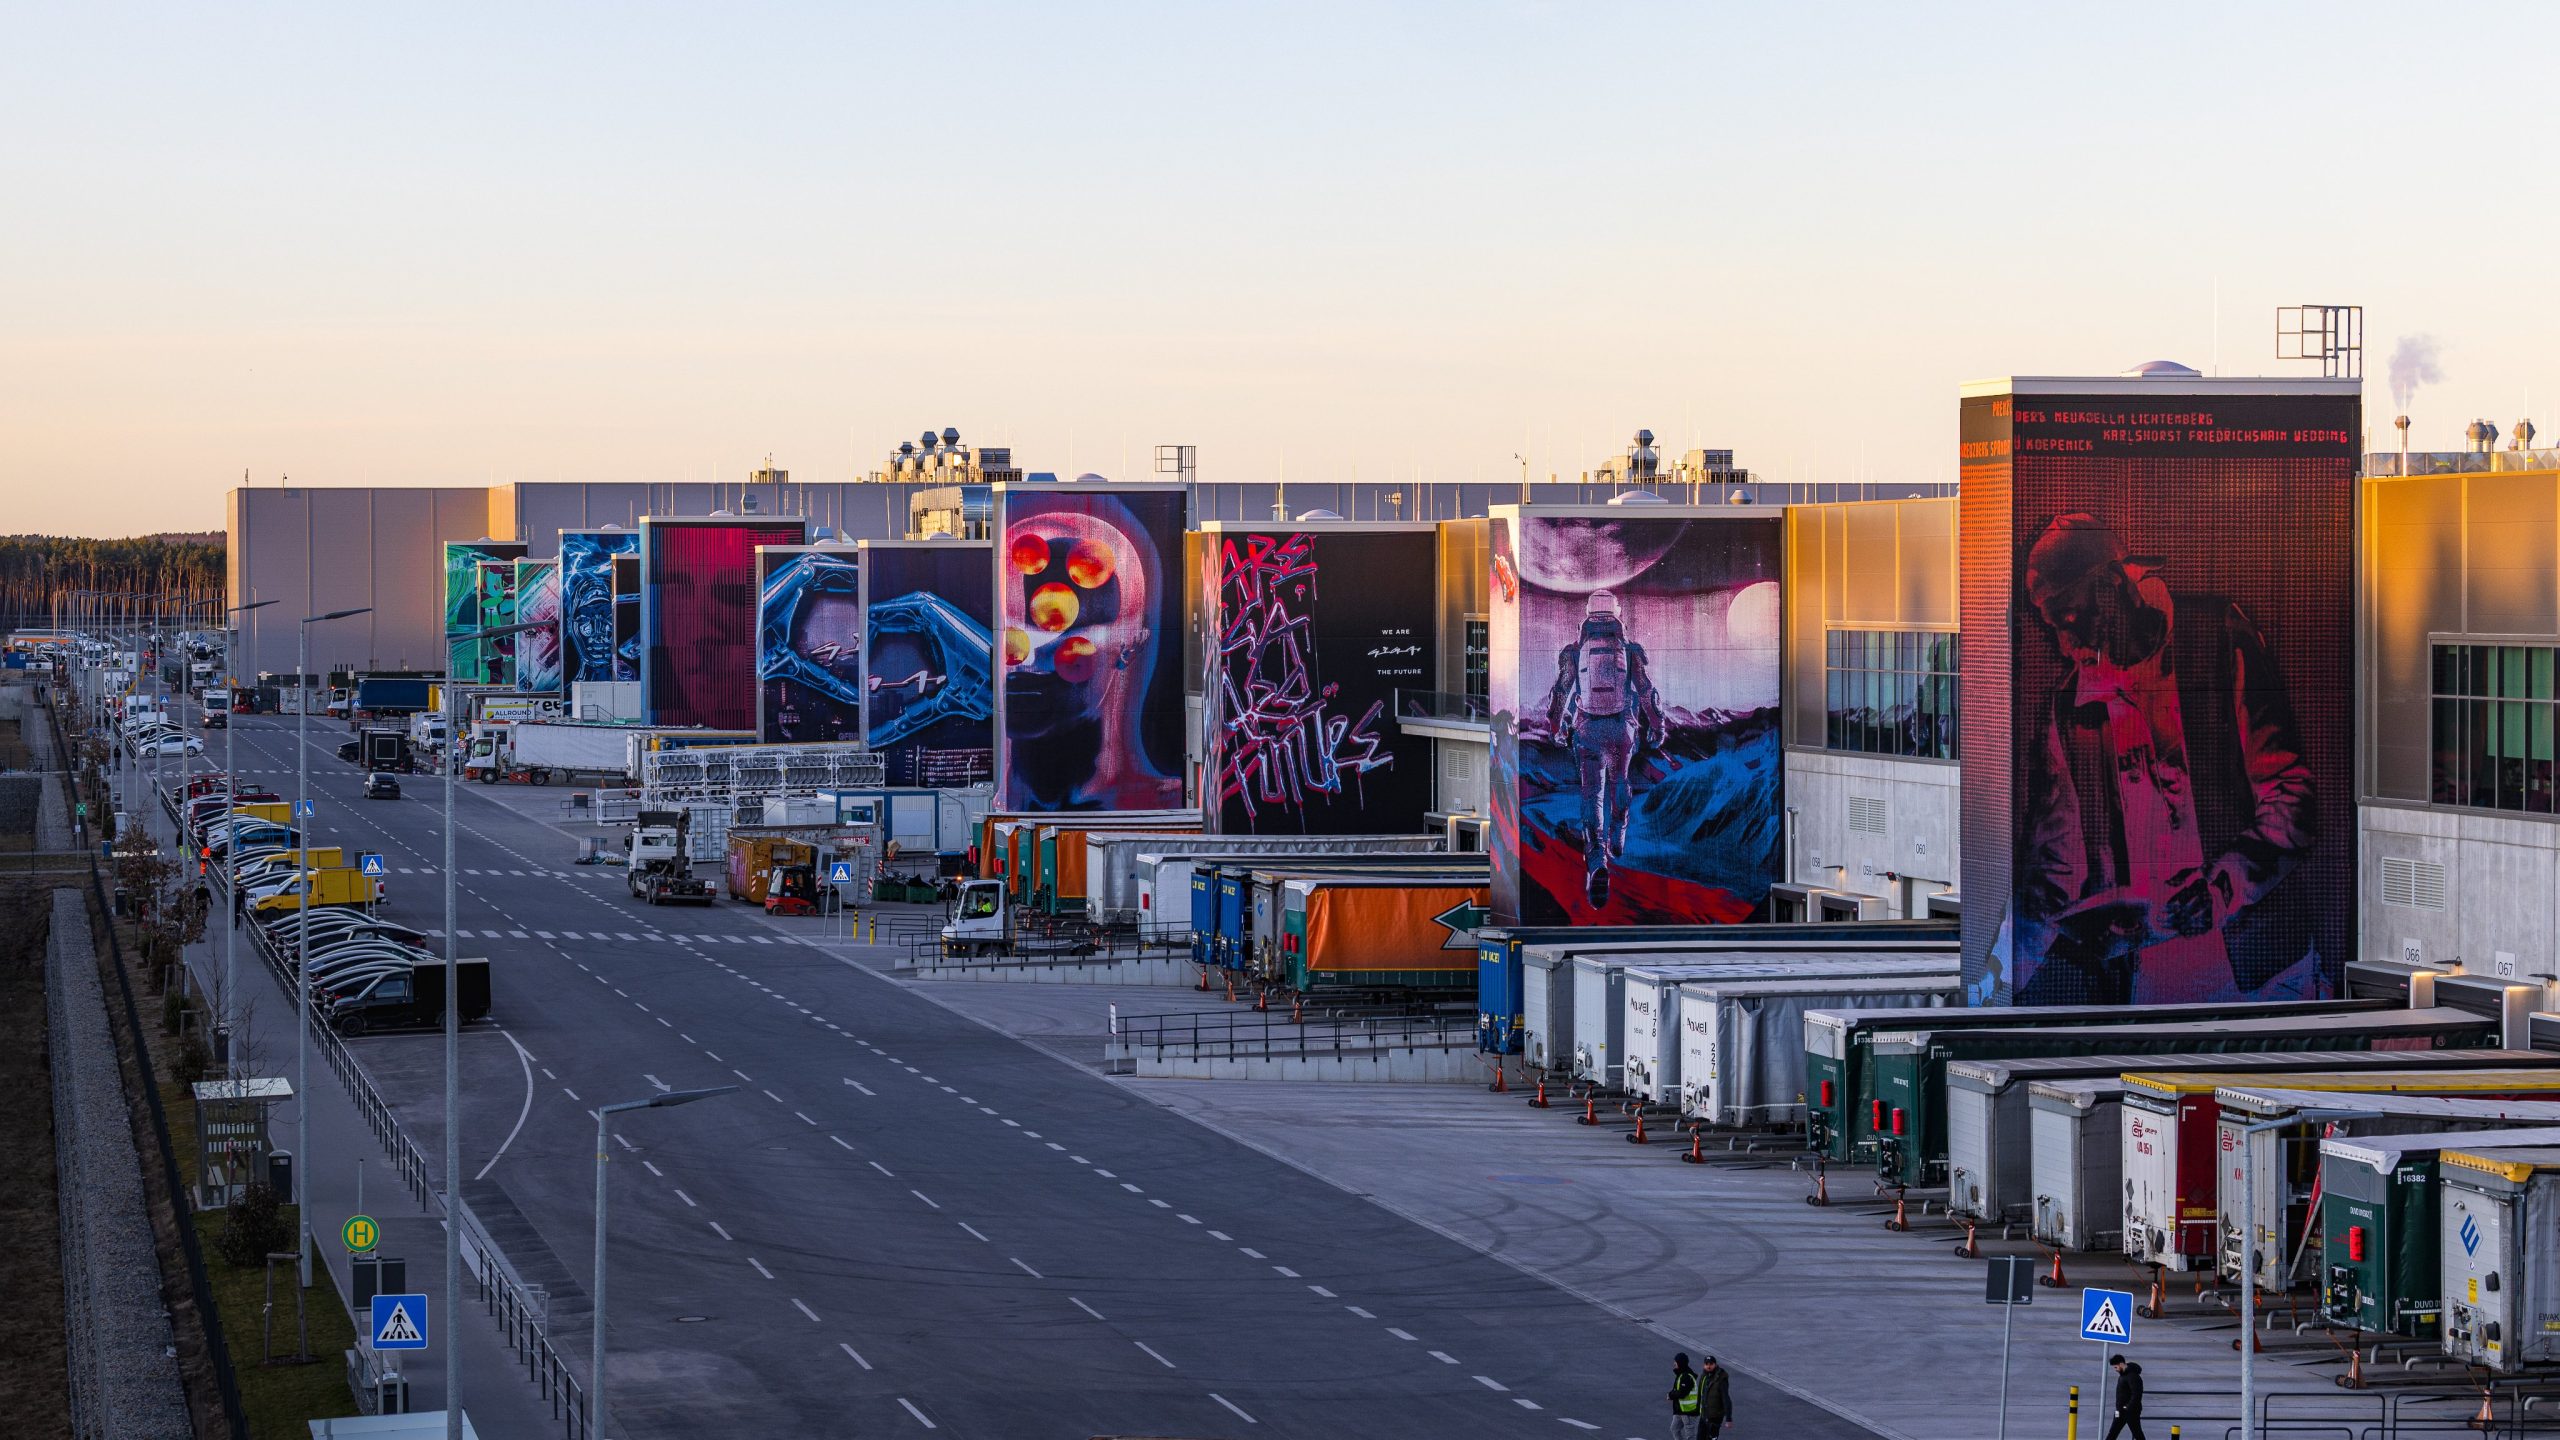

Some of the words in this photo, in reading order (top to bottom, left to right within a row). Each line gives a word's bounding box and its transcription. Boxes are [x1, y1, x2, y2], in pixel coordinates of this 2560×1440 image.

[2131, 413, 2214, 426] LICHTENBERG
[2103, 429, 2182, 444] KARLSHORST
[2189, 428, 2287, 443] FRIEDRICHSHAIN
[2294, 429, 2348, 443] WEDDING
[2026, 438, 2093, 451] KOEPENICK
[2405, 947, 2420, 962] 066
[2497, 961, 2513, 976] 067
[2402, 1174, 2426, 1183] 16382
[353, 1223, 368, 1244] H
[2414, 1300, 2434, 1309] DUVO
